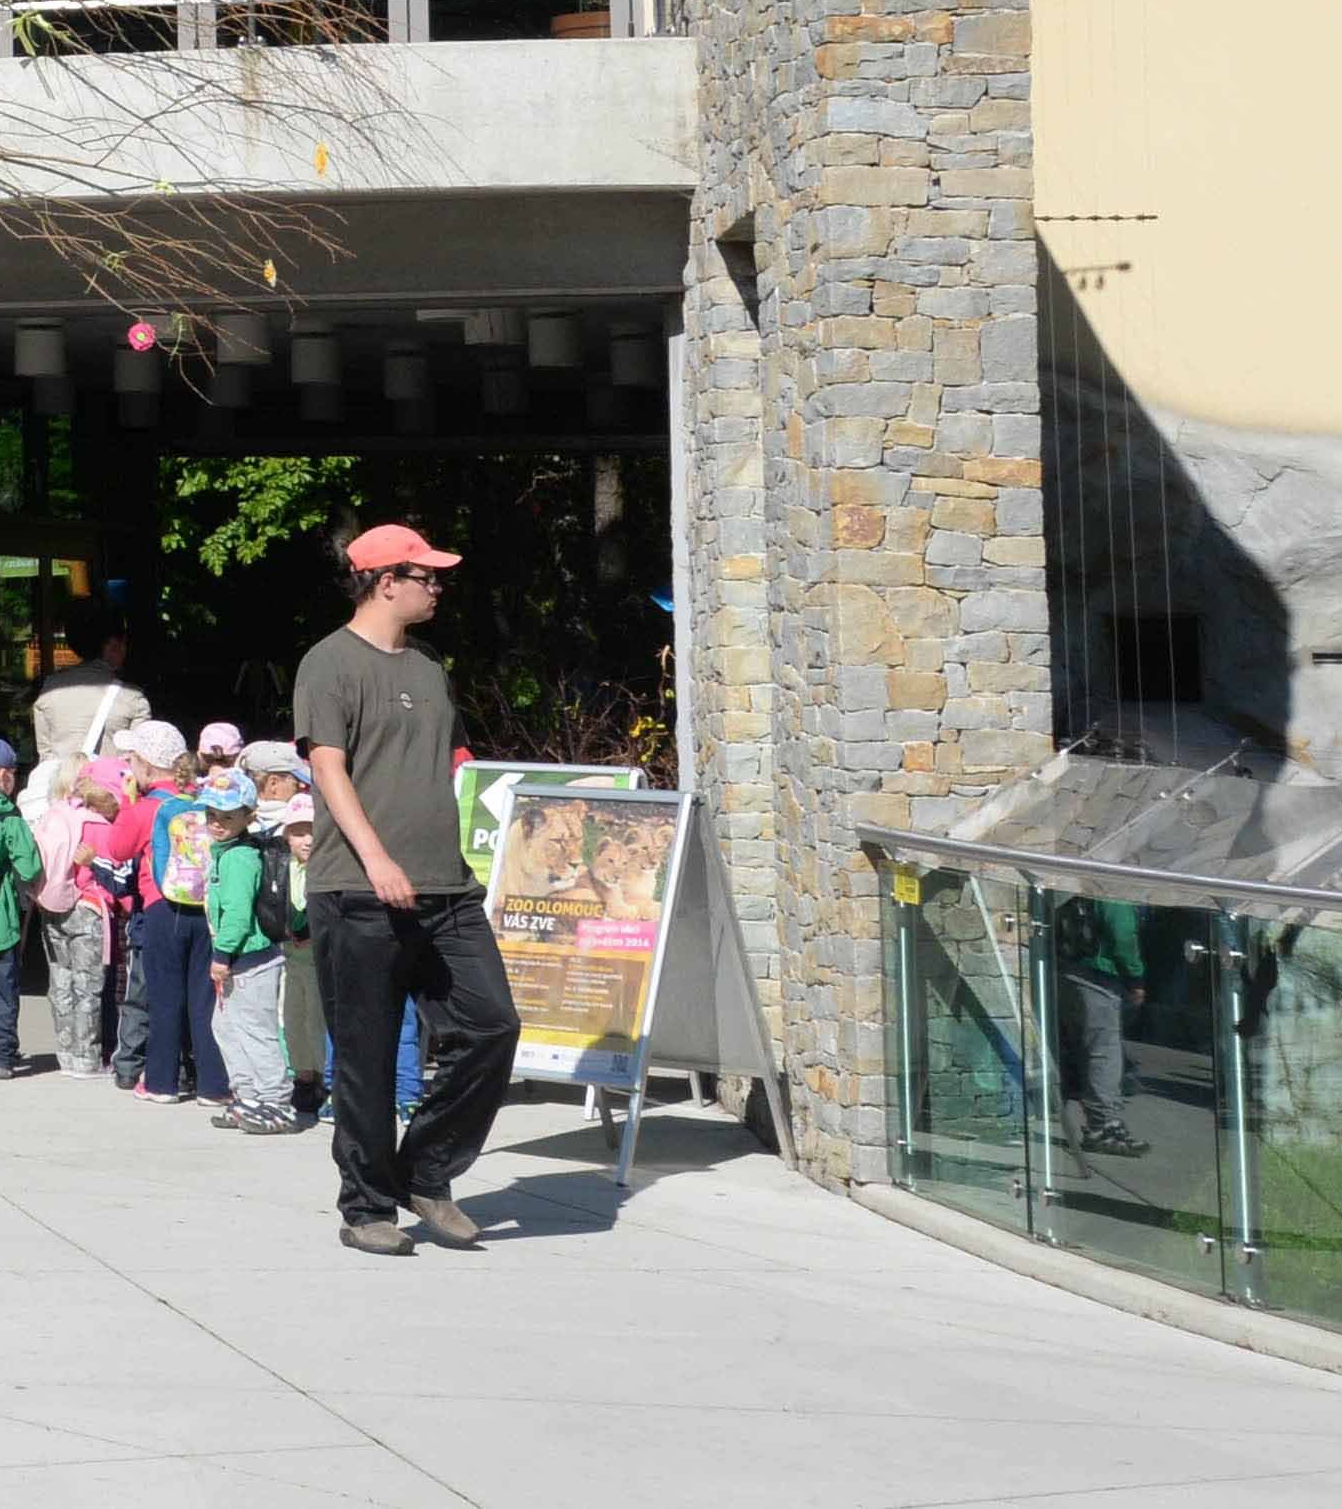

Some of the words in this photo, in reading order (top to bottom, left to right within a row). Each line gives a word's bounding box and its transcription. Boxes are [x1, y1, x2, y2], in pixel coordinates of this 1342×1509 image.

[505, 898, 534, 914] ZOO
[535, 901, 604, 918] OLOMOUC
[502, 912, 532, 929] VÁS
[530, 915, 556, 932] ZVE
